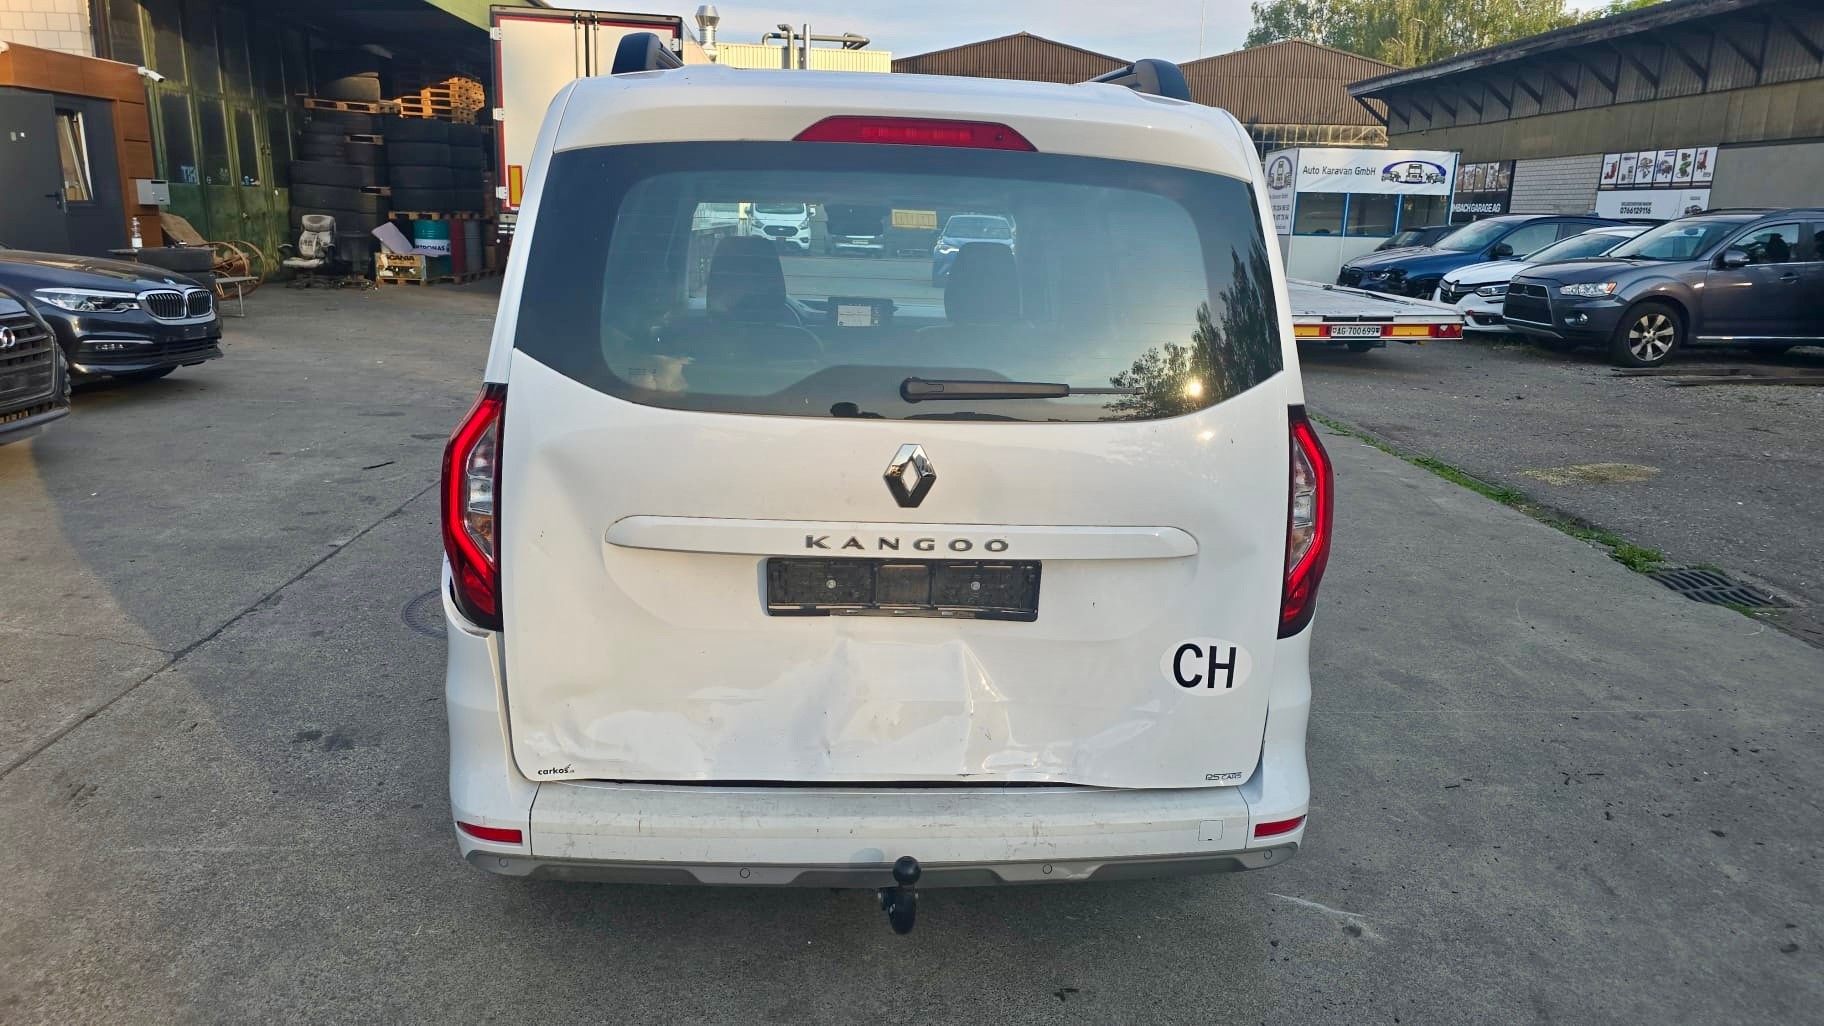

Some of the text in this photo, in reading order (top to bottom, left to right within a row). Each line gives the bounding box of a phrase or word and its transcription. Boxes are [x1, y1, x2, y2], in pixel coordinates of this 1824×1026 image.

[1302, 165, 1377, 176] Auto Karavan GmbH
[1471, 203, 1492, 213] GARAGE
[1492, 203, 1501, 213] AG
[805, 534, 1009, 552] KANGOO
[1172, 643, 1237, 689] CH
[537, 767, 569, 776] carkos
